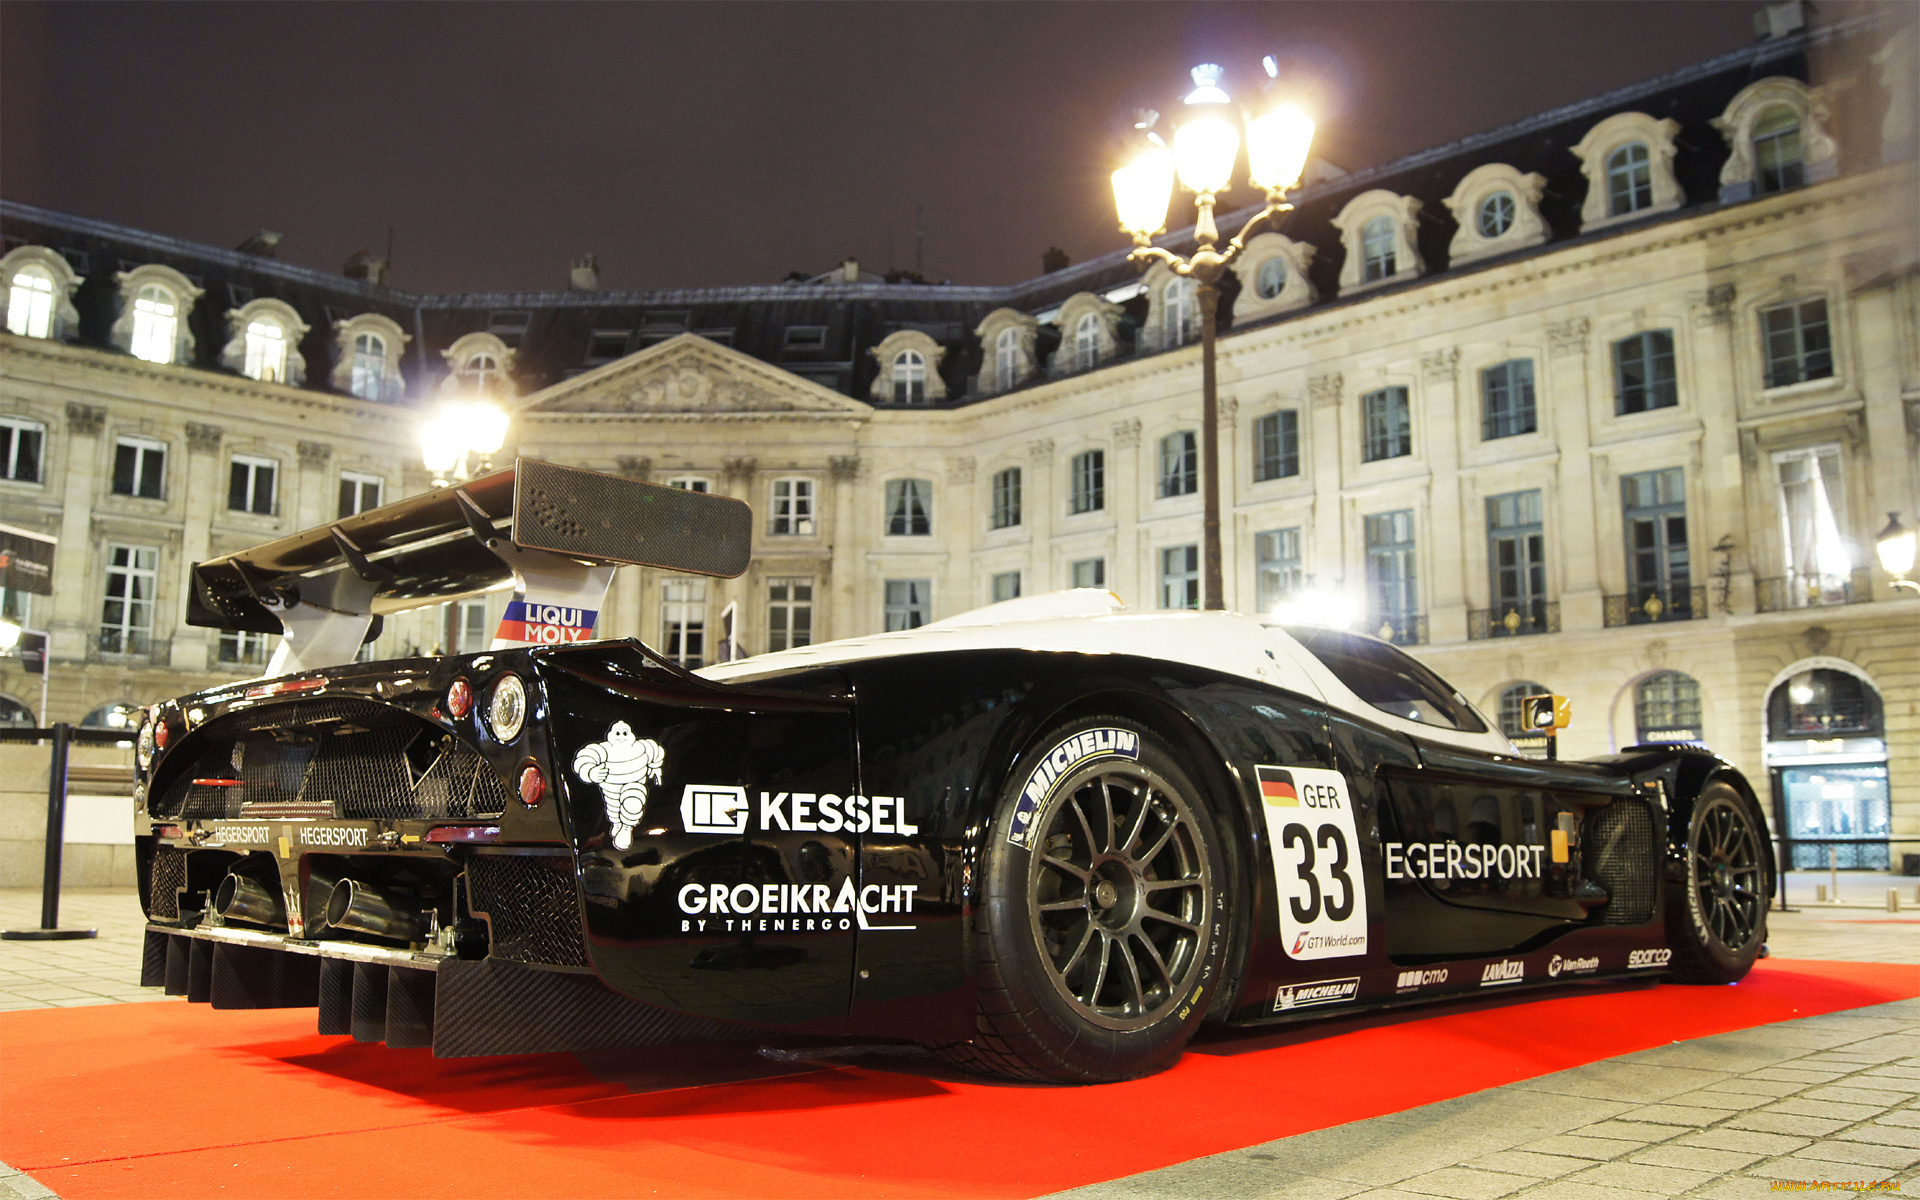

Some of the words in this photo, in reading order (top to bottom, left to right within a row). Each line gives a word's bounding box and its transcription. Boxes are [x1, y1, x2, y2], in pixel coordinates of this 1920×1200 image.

[525, 604, 582, 626] LIQUI
[525, 624, 582, 644] MOLY
[1646, 729, 1697, 743] CHANEL
[1025, 730, 1135, 808] MICHELIN
[1303, 784, 1341, 810] GER
[760, 791, 918, 836] KESSEL
[215, 826, 270, 844] HEGERSPORT
[300, 827, 368, 847] HEGERSPORT
[1380, 842, 1545, 879] EGERSPORT
[1282, 822, 1355, 925] 33
[677, 876, 918, 918] GROEIKRACHT
[681, 919, 707, 932] BY
[726, 918, 851, 931] THENERGO
[1308, 933, 1365, 950] GT1World.com
[1628, 948, 1672, 966] sparco
[1422, 968, 1449, 986] cmo
[1481, 959, 1525, 982] LAVAZZA
[1295, 982, 1356, 1001] MICHELIN
